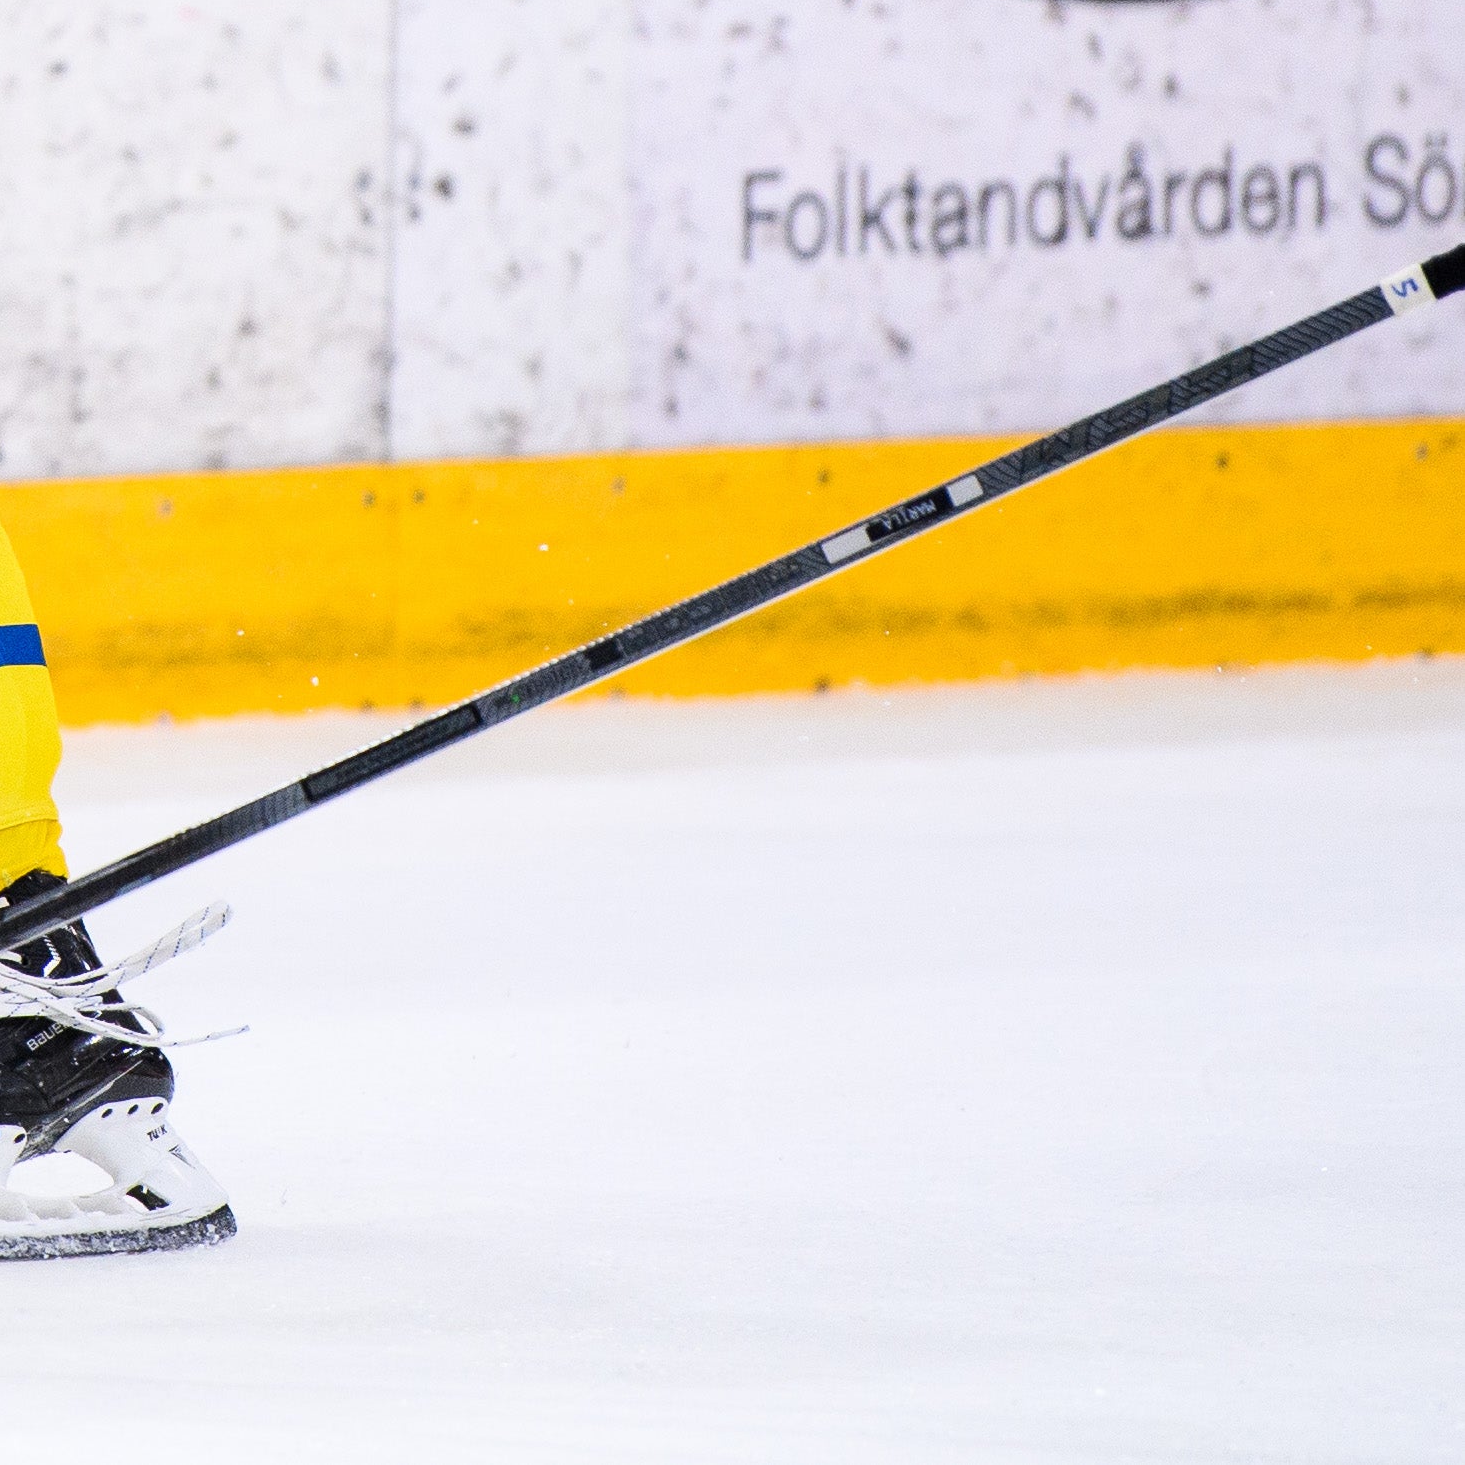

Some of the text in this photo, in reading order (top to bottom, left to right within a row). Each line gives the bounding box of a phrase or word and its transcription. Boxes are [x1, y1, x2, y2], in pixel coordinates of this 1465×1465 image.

[740, 132, 1465, 263] Folktandvården Sö
[26, 1021, 69, 1051] BAUE
